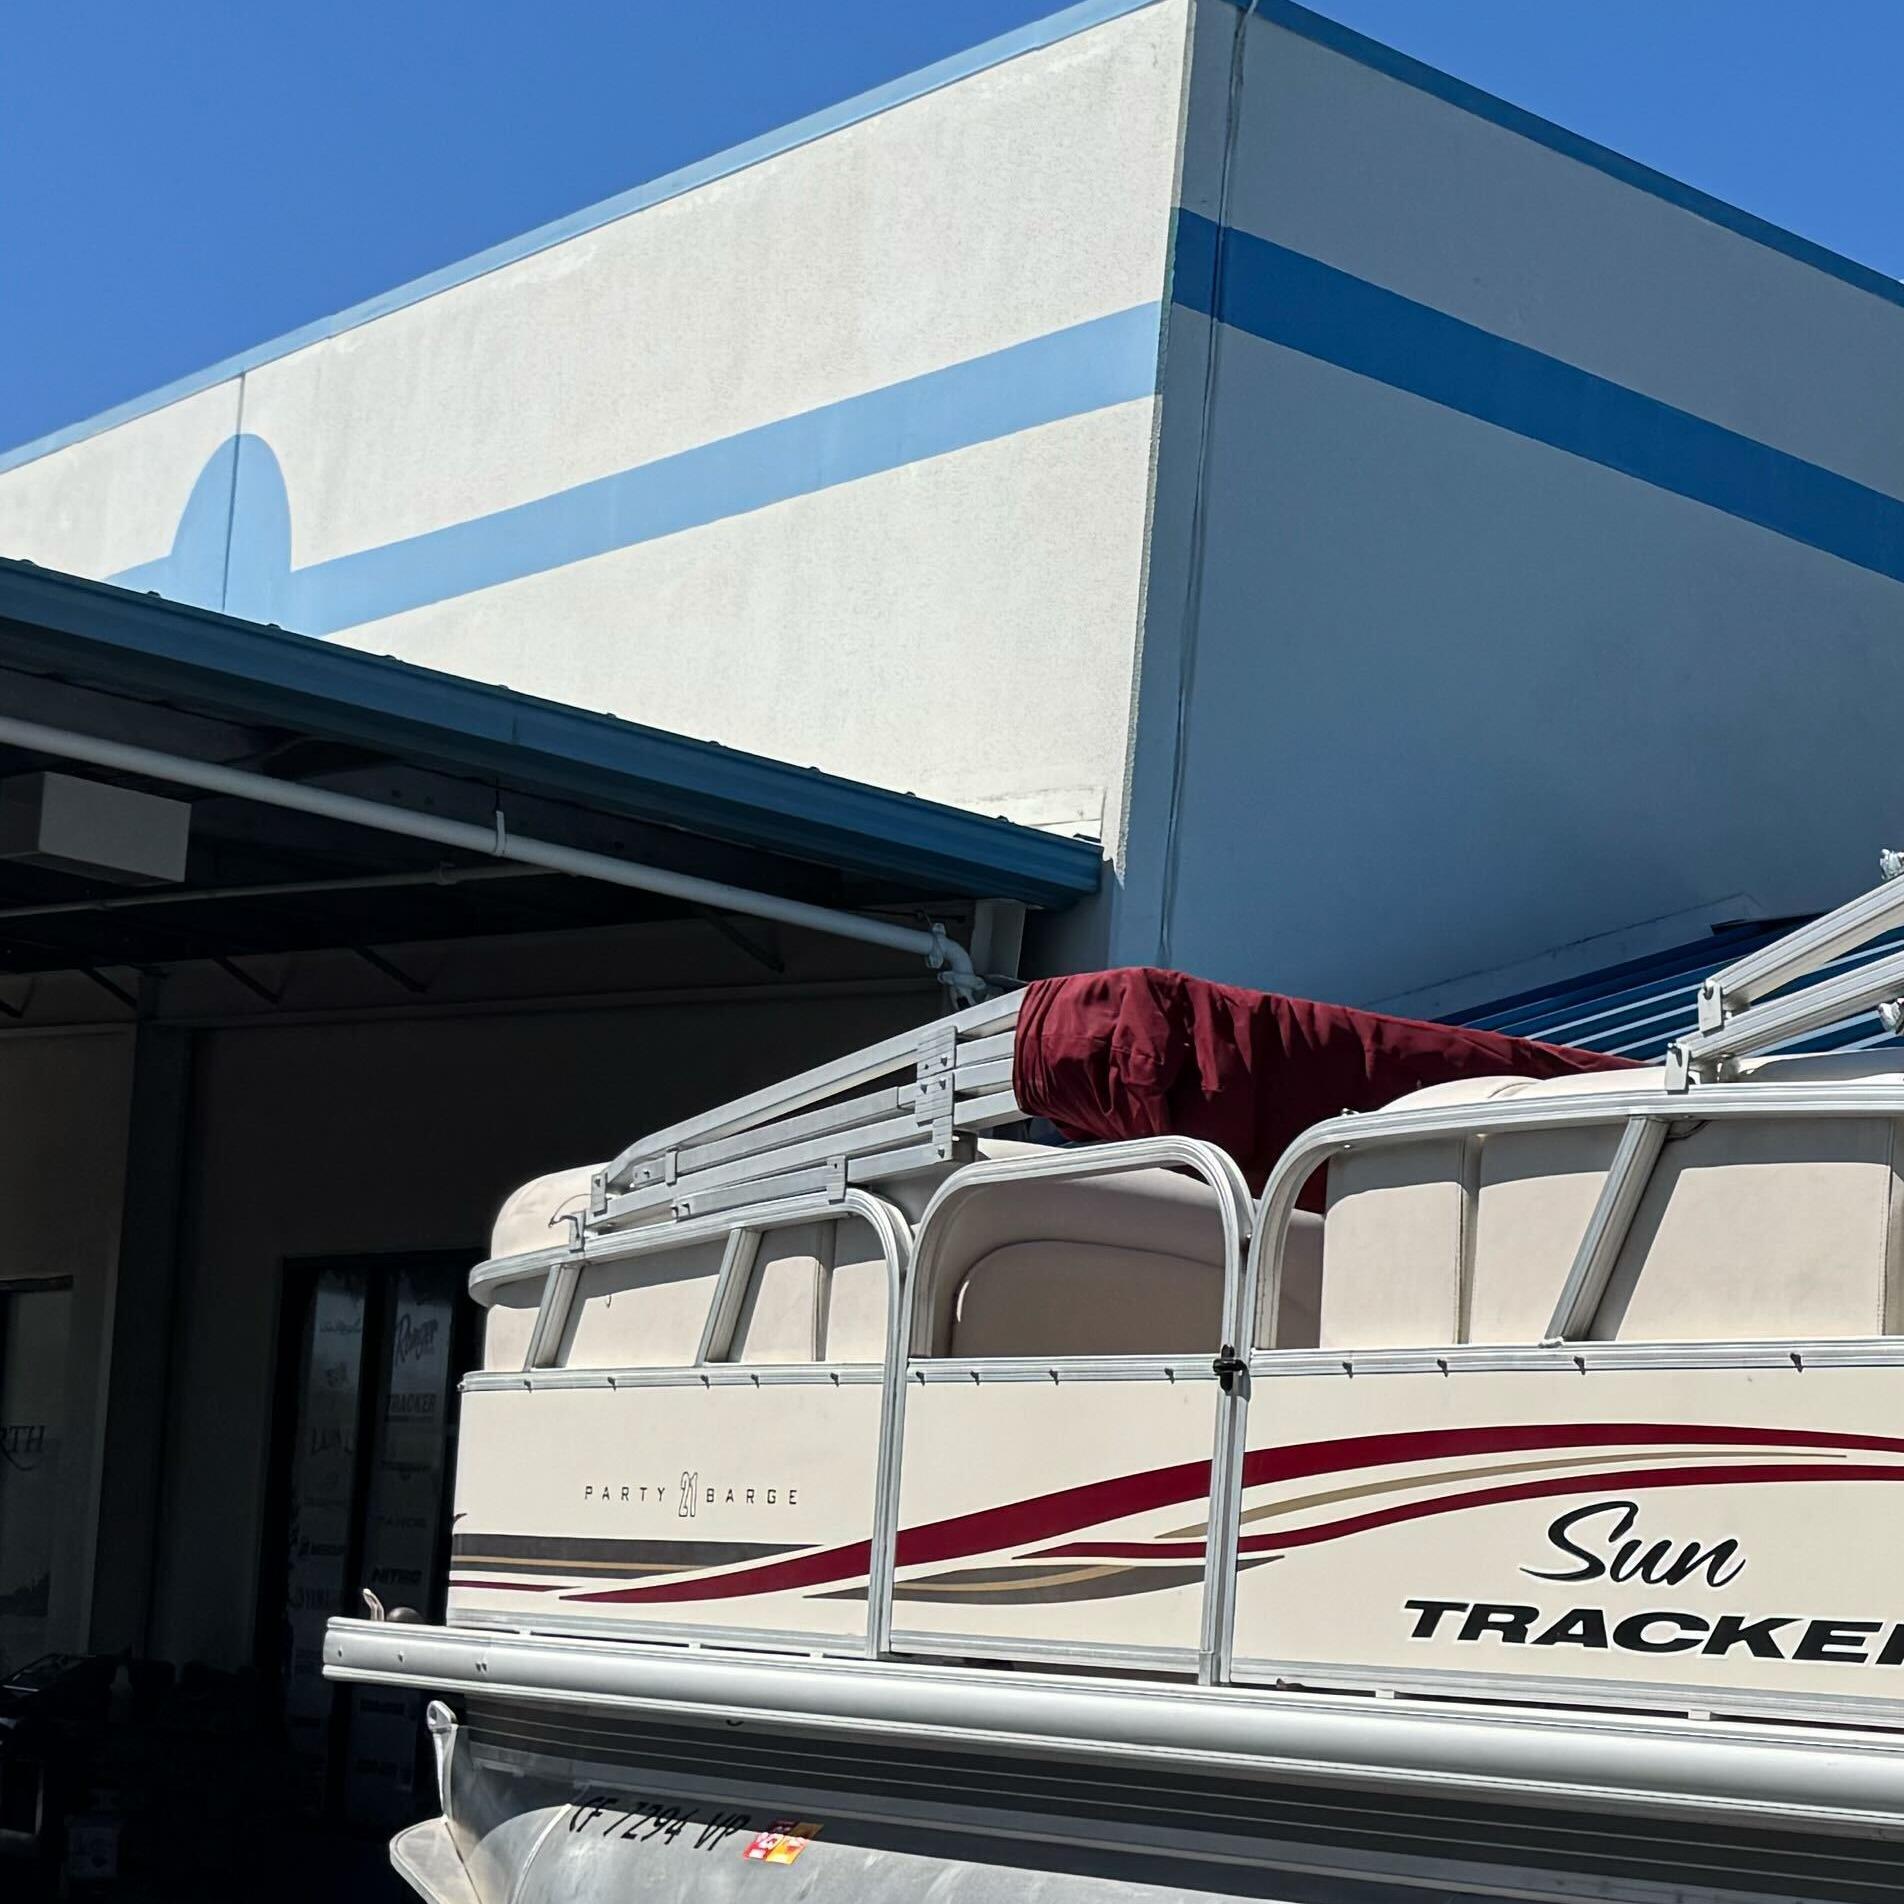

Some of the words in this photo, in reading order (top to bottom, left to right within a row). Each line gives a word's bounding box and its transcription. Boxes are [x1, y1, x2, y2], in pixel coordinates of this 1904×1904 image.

[584, 1485, 666, 1501] PARTY
[678, 1470, 698, 1518] 21
[706, 1487, 798, 1505] BARGE
[1519, 1500, 1747, 1588] Sun
[603, 1801, 699, 1846] 7294
[692, 1811, 752, 1851] VP
